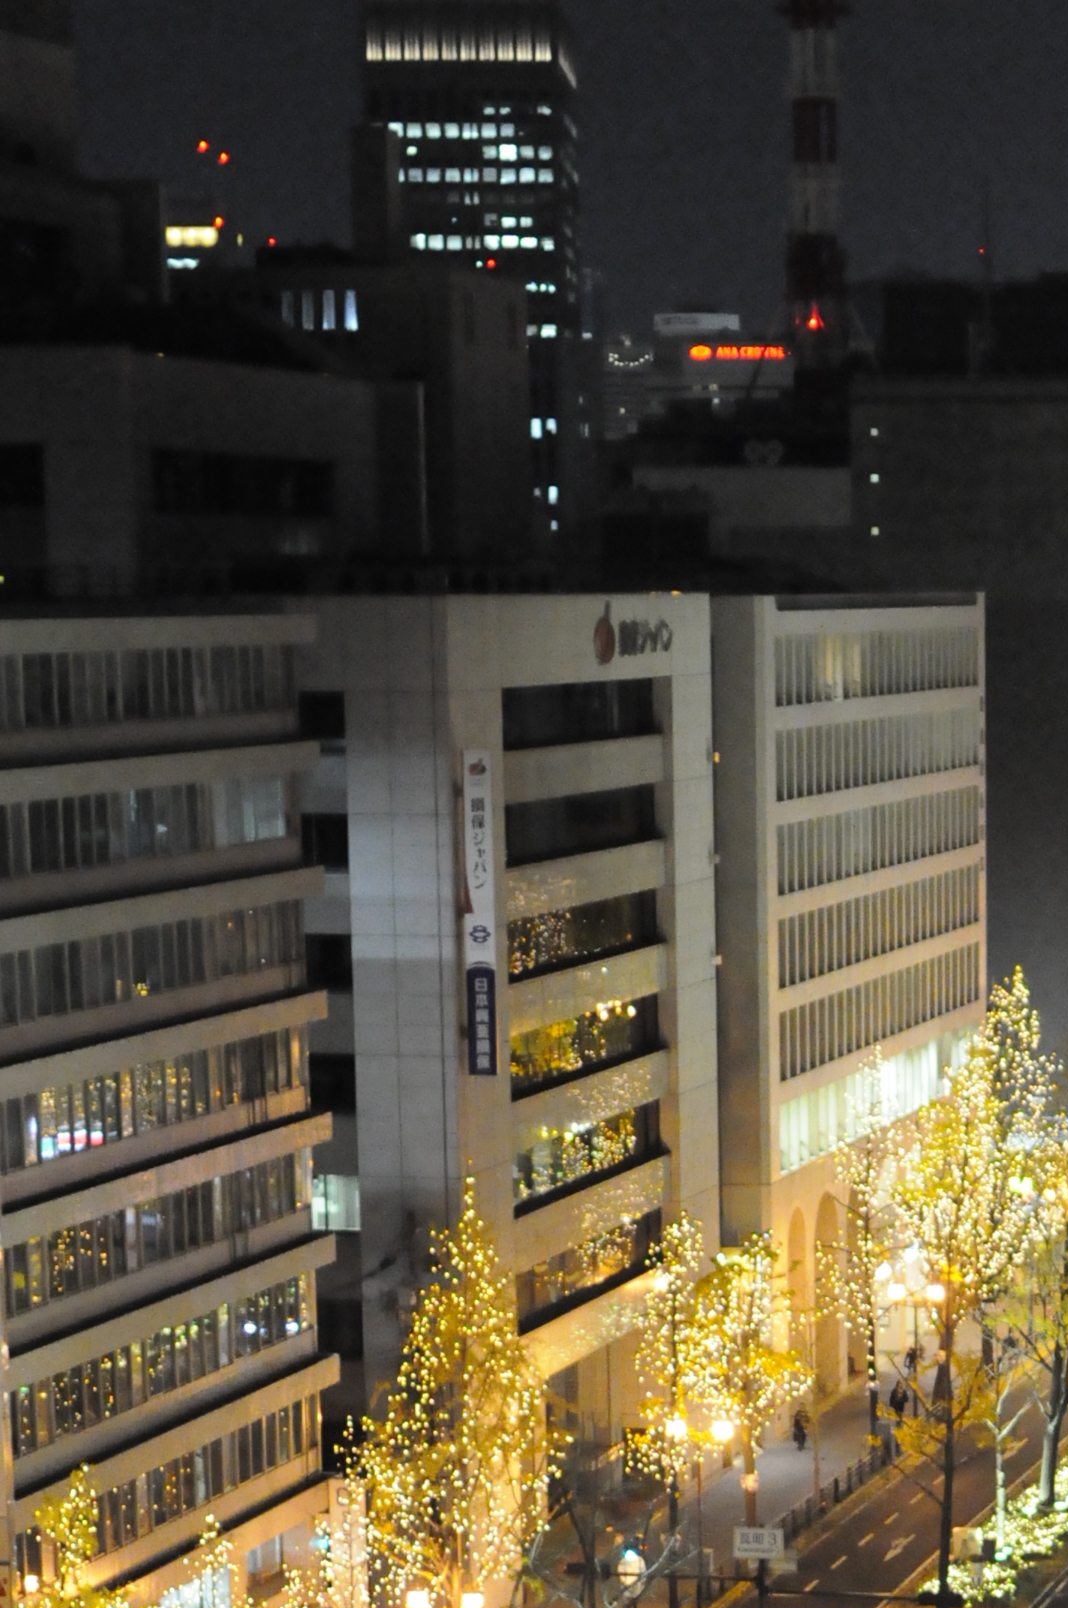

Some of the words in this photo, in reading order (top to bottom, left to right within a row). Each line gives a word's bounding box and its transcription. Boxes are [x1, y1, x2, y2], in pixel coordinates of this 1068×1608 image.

[716, 345, 738, 359] ANA
[470, 796, 488, 890] 損保ジャパン
